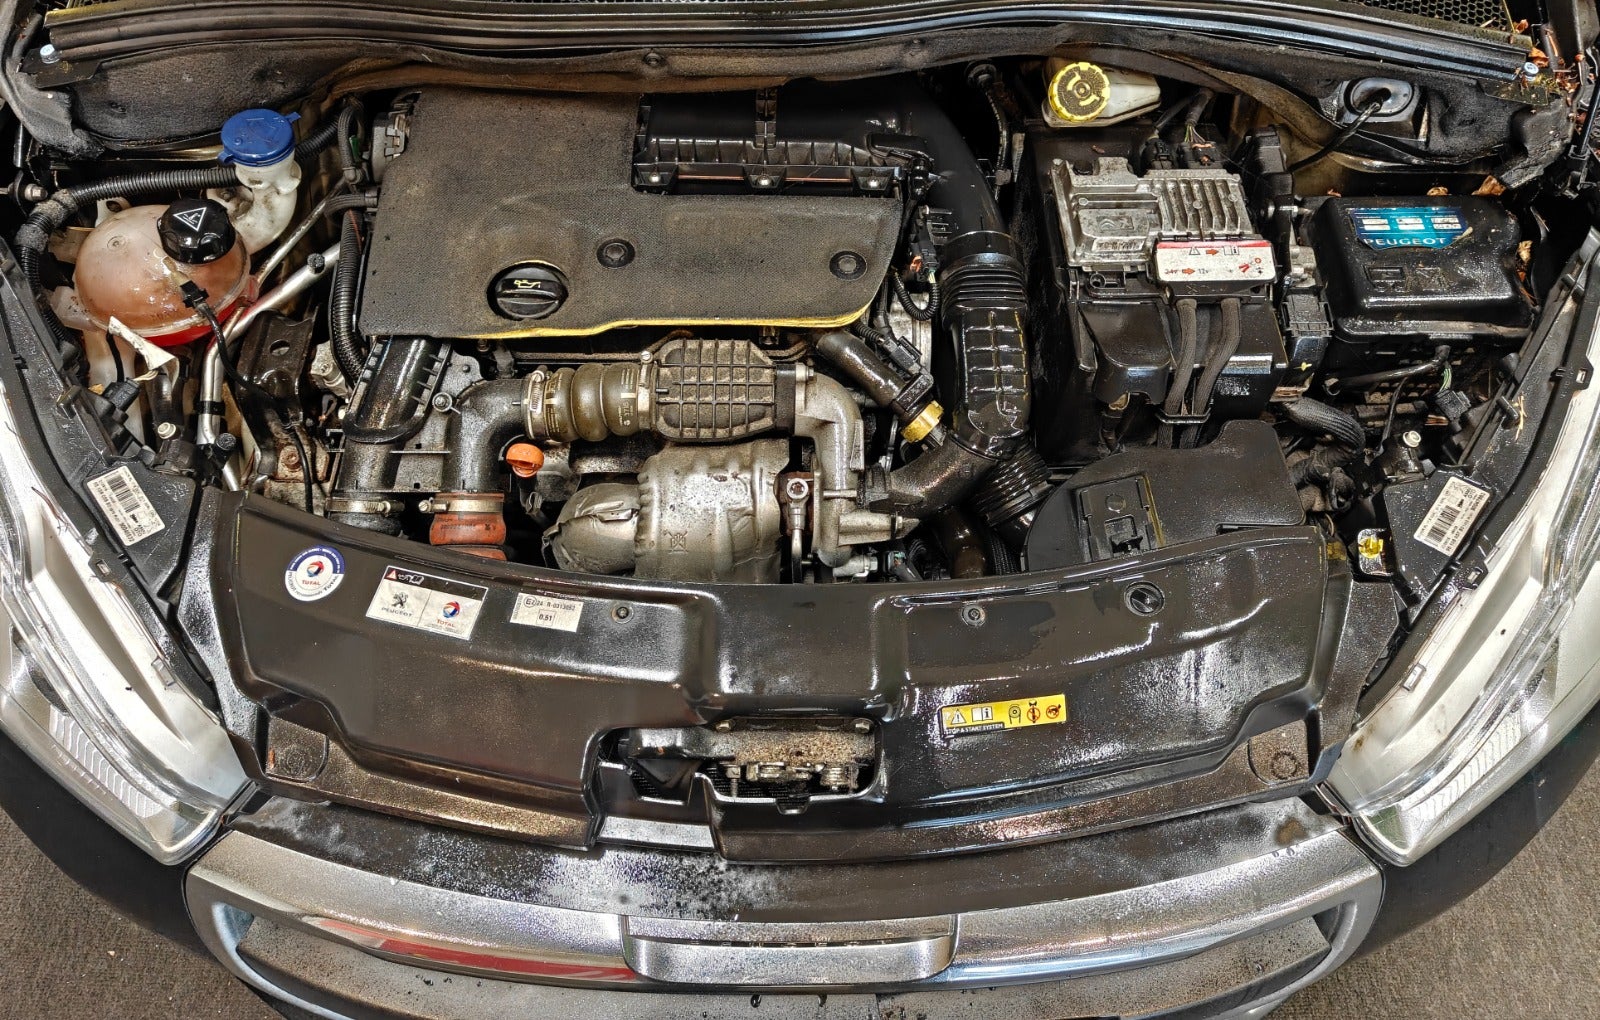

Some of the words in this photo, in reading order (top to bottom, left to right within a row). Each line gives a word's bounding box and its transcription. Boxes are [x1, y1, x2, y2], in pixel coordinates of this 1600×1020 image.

[1363, 237, 1446, 246] PEUGEOT
[381, 606, 413, 617] PEUGEOT
[436, 618, 456, 628] TOTAL
[983, 723, 1004, 731] SYSTEM
